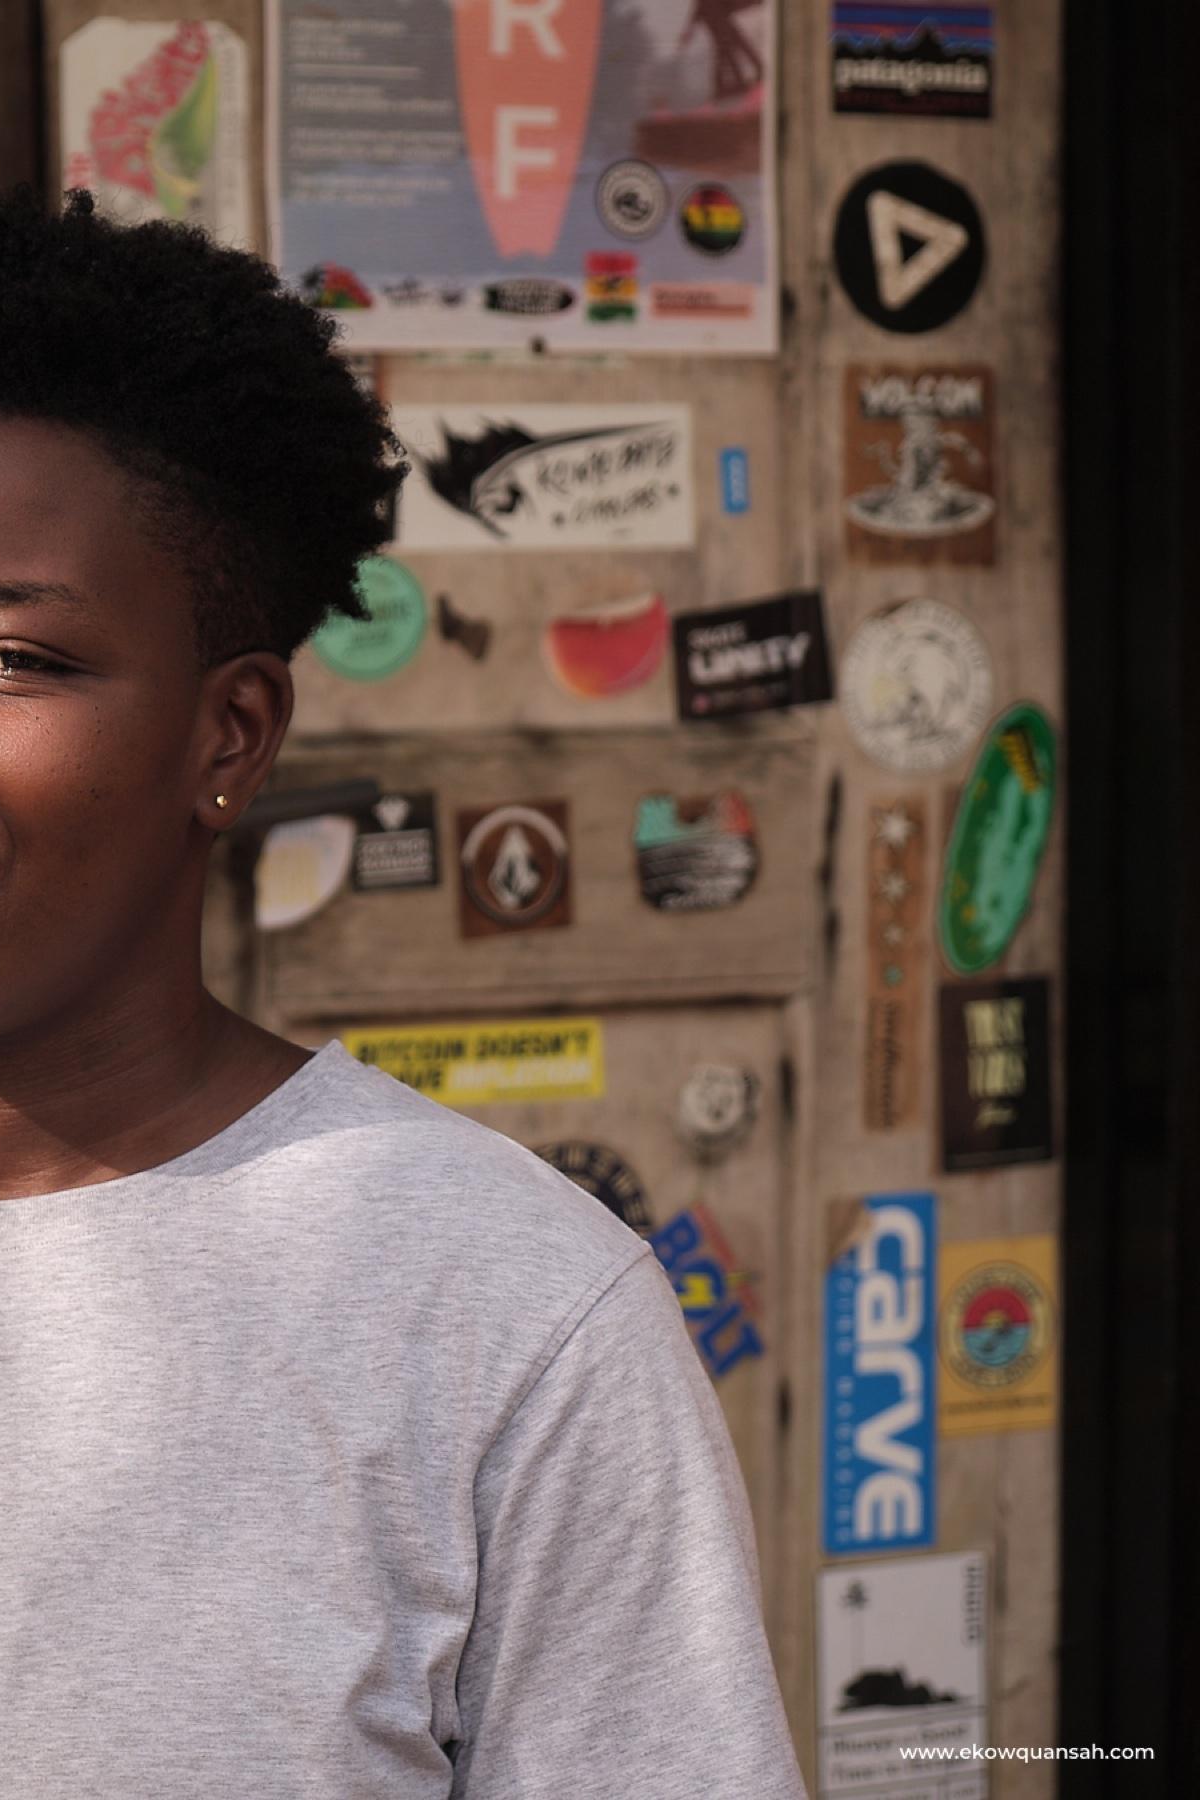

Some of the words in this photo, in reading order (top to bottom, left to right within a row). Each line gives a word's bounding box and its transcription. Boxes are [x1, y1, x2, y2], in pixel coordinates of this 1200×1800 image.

[835, 57, 988, 95] patagonia
[862, 374, 984, 416] VOLCOM
[648, 1208, 765, 1378] BOLT
[853, 1202, 925, 1542] carve
